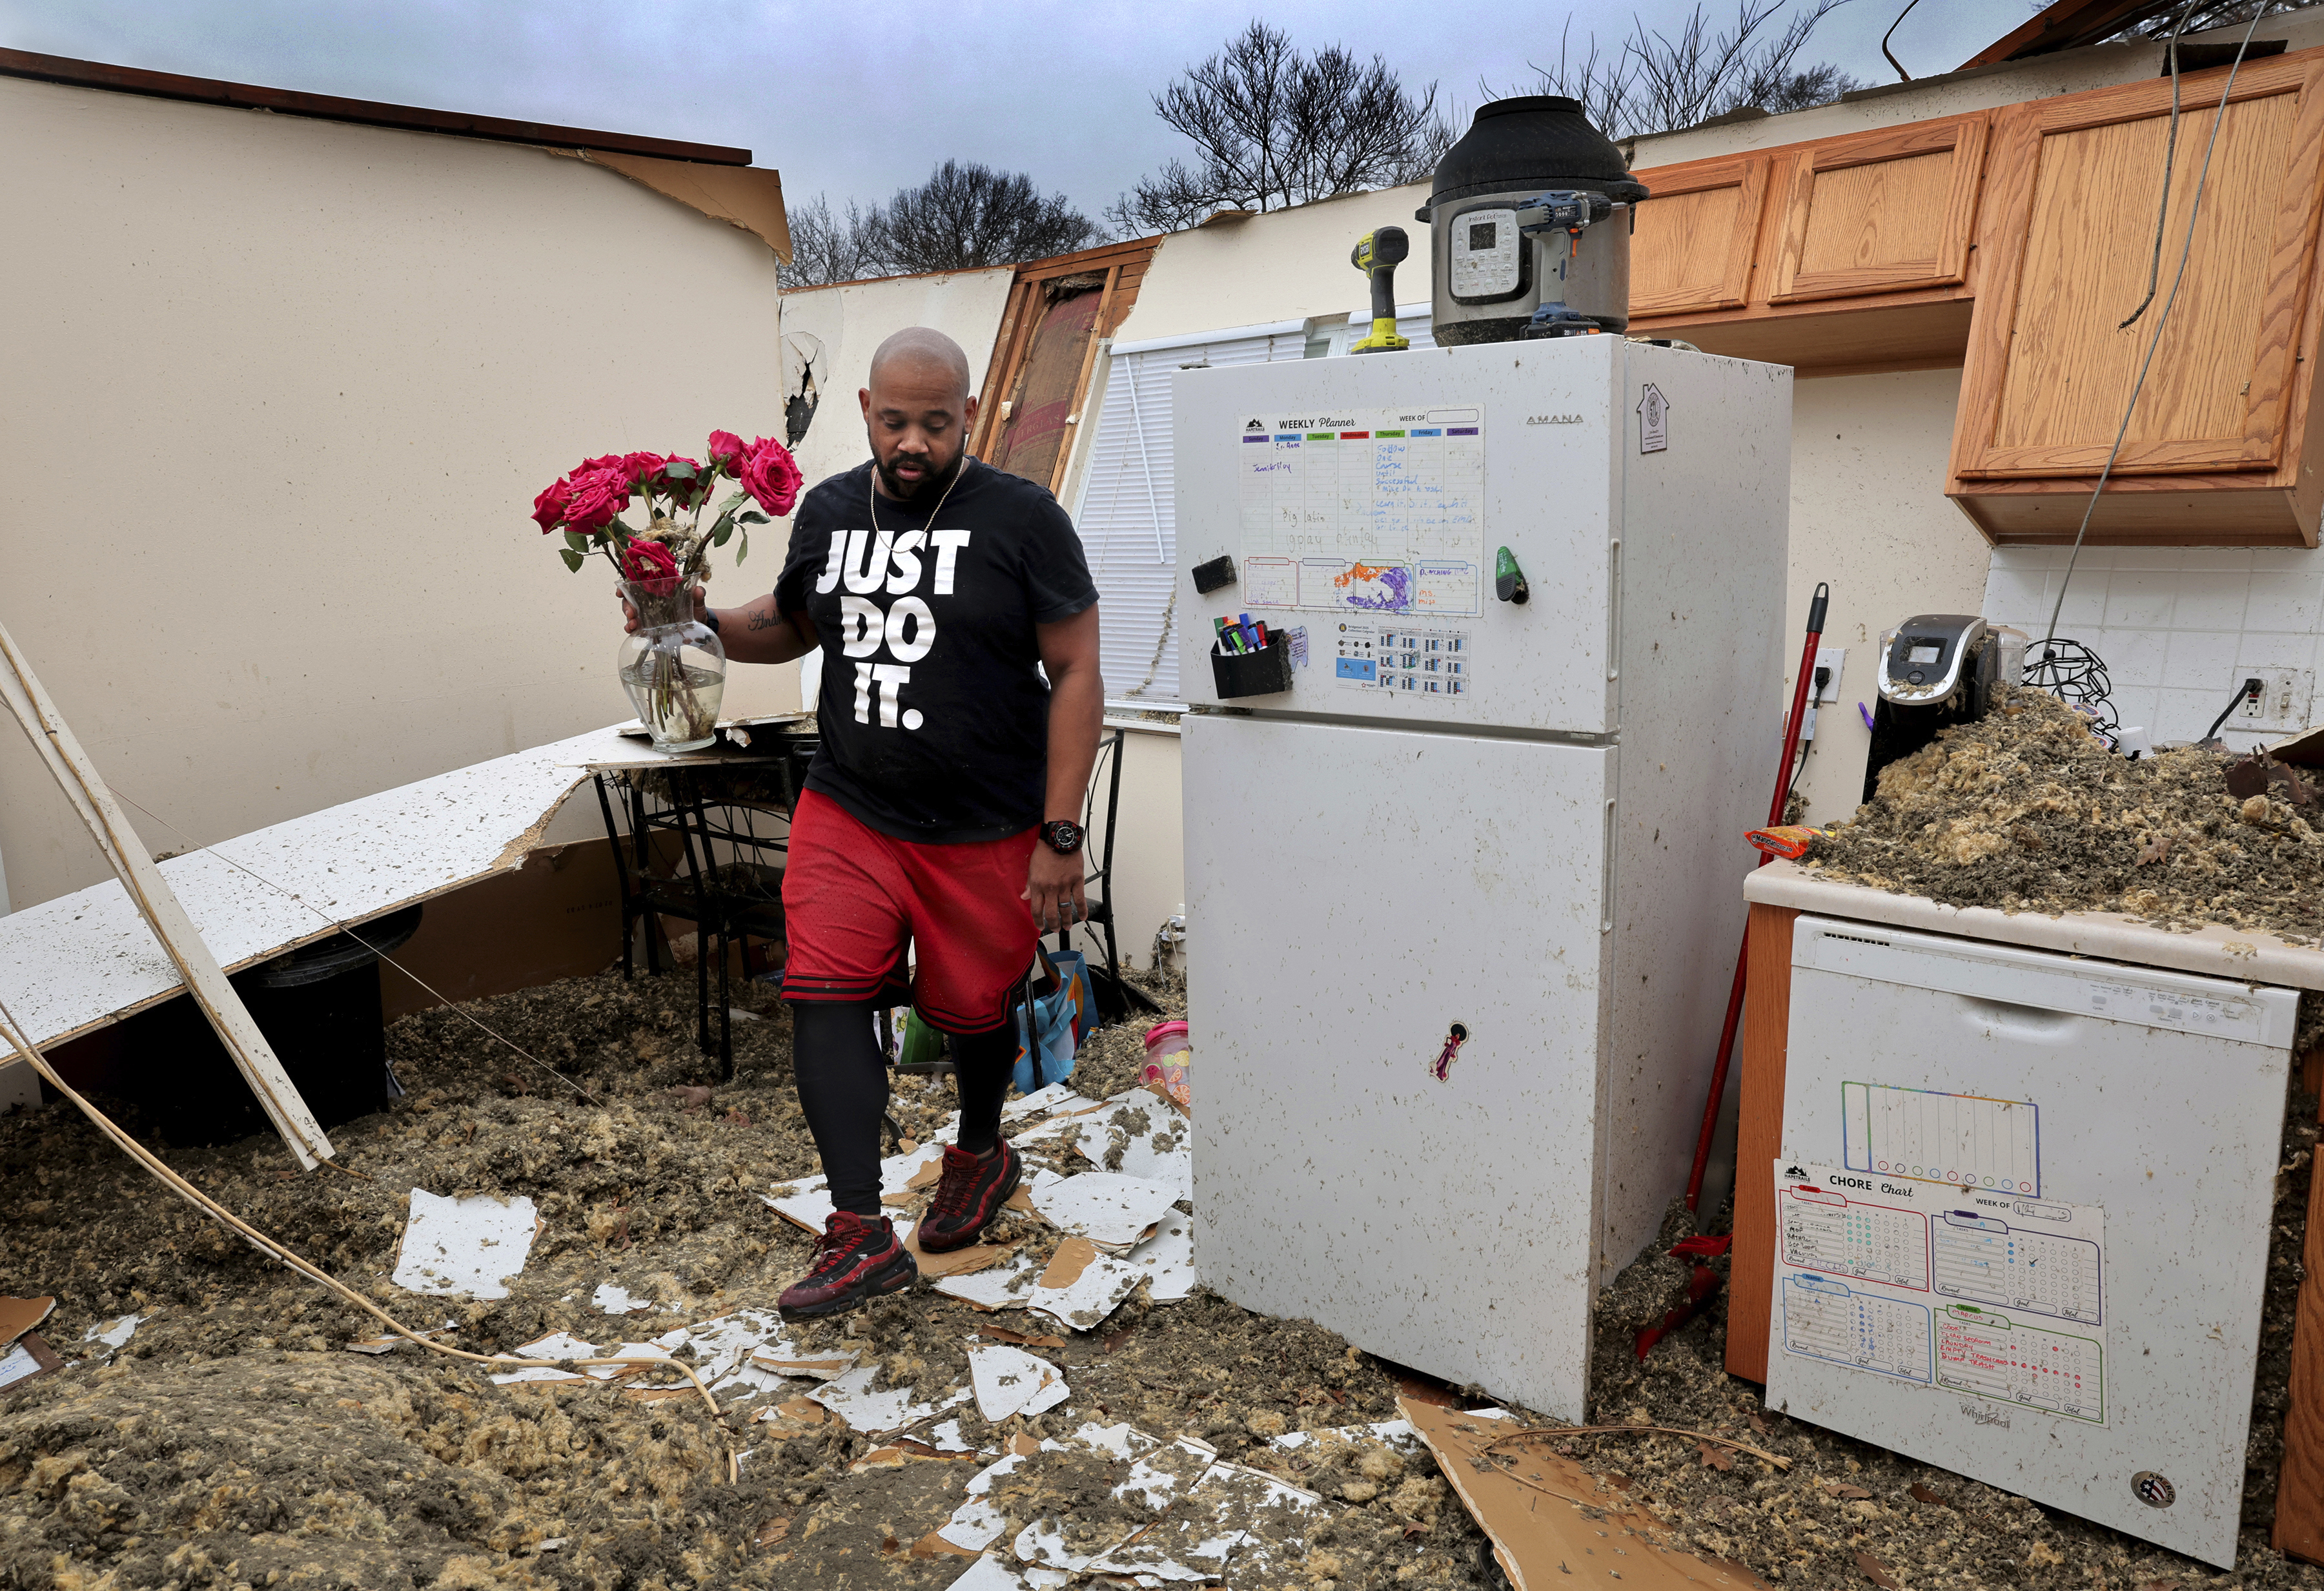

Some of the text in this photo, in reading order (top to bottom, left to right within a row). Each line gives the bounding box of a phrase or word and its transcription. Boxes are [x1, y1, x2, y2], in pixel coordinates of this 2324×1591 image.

[1279, 417, 1356, 429] WEEKLY Planner
[1527, 414, 1584, 424] AMANA
[815, 529, 971, 595] JUST
[841, 595, 936, 662] DO
[853, 662, 923, 730] IT.
[1756, 834, 1793, 852] Maruchan Ramen
[1830, 1175, 1914, 1198] CHORE Chart
[1975, 1198, 1997, 1207] WEEK
[1788, 1255, 1805, 1264] Reward
[1896, 1277, 1910, 1286] Total
[1941, 1285, 1960, 1294] Reward
[2064, 1309, 2079, 1319] Total
[1791, 1342, 1809, 1351] Reward
[1899, 1367, 1912, 1376] Total
[1943, 1377, 1964, 1386] Reward
[2019, 1393, 2032, 1402] Goal
[2066, 1406, 2081, 1415] Total
[1961, 1405, 2011, 1428] Whirlpool
[2148, 1473, 2174, 1504] AMERICA
